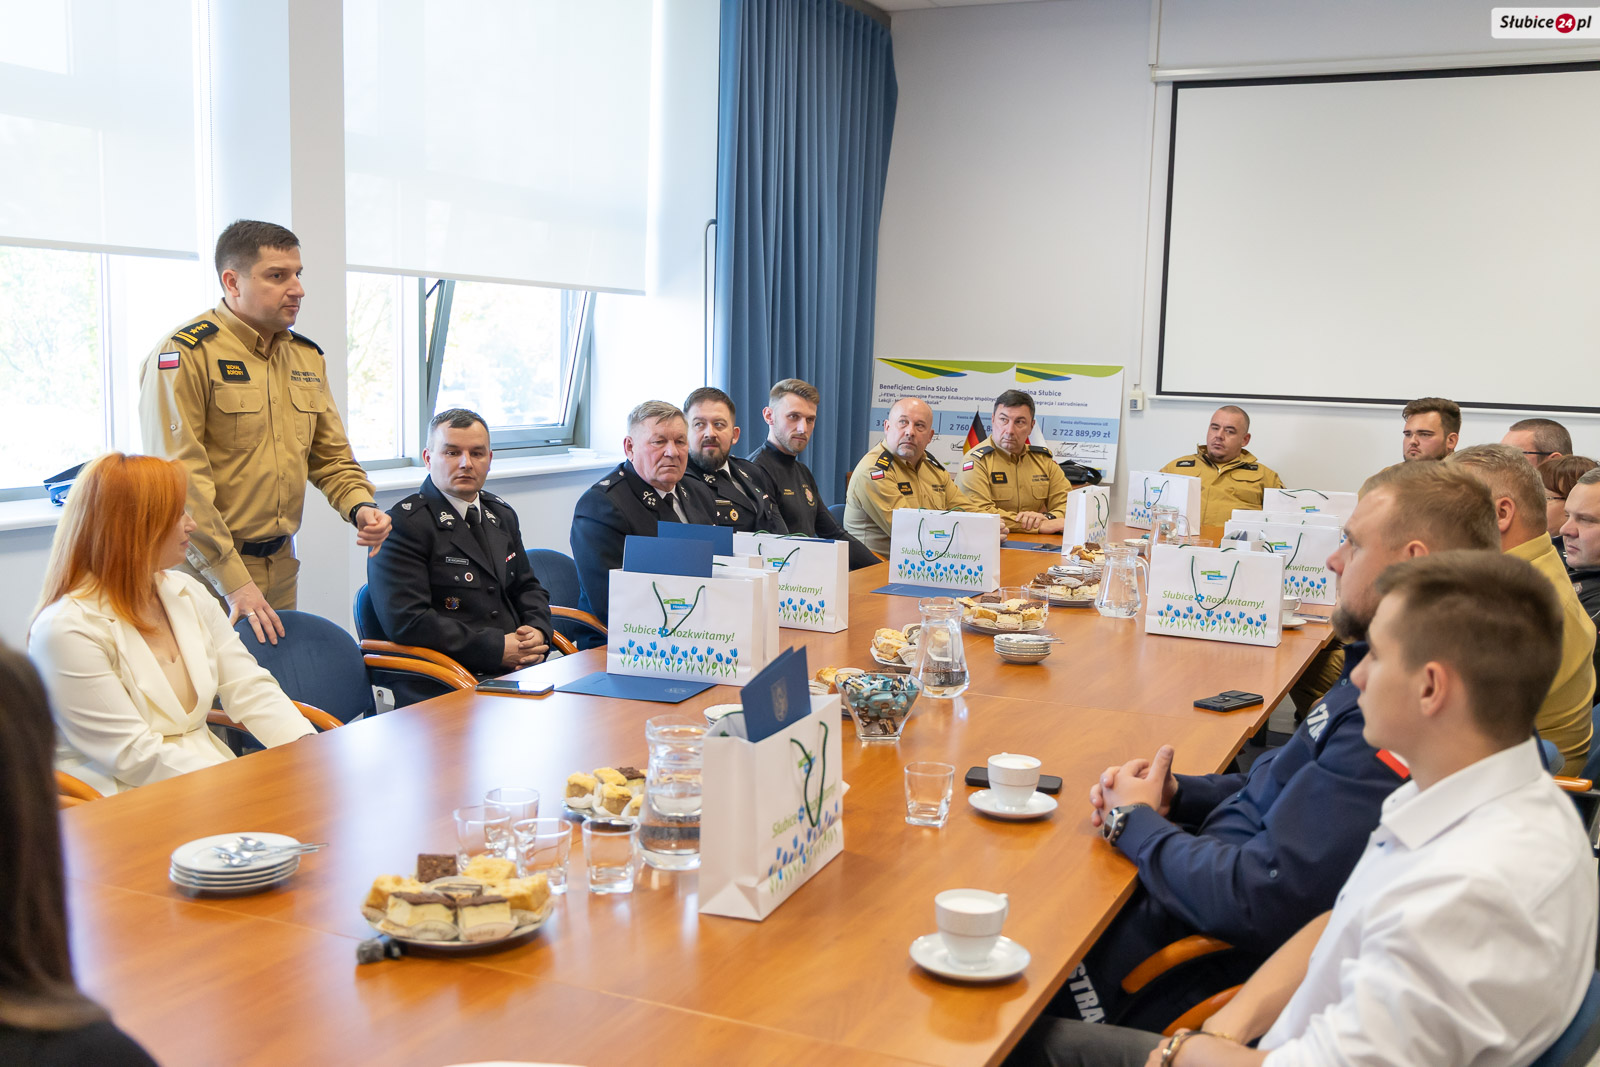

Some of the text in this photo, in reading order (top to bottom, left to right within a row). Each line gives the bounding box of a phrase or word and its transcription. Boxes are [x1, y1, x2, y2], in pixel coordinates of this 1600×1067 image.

[879, 383, 915, 391] Beneficjent:
[1038, 389, 1062, 397] Słubice
[949, 423, 970, 431] 2 760
[1052, 428, 1058, 436] 2
[1059, 429, 1074, 437] 722
[1075, 430, 1102, 439] 889,99
[1287, 564, 1325, 574] kwitamy!
[778, 583, 823, 596] zkwitamy!
[1205, 594, 1265, 609] Rozkwitamy!
[623, 623, 657, 635] Słubice
[1069, 961, 1106, 1024] STRA
